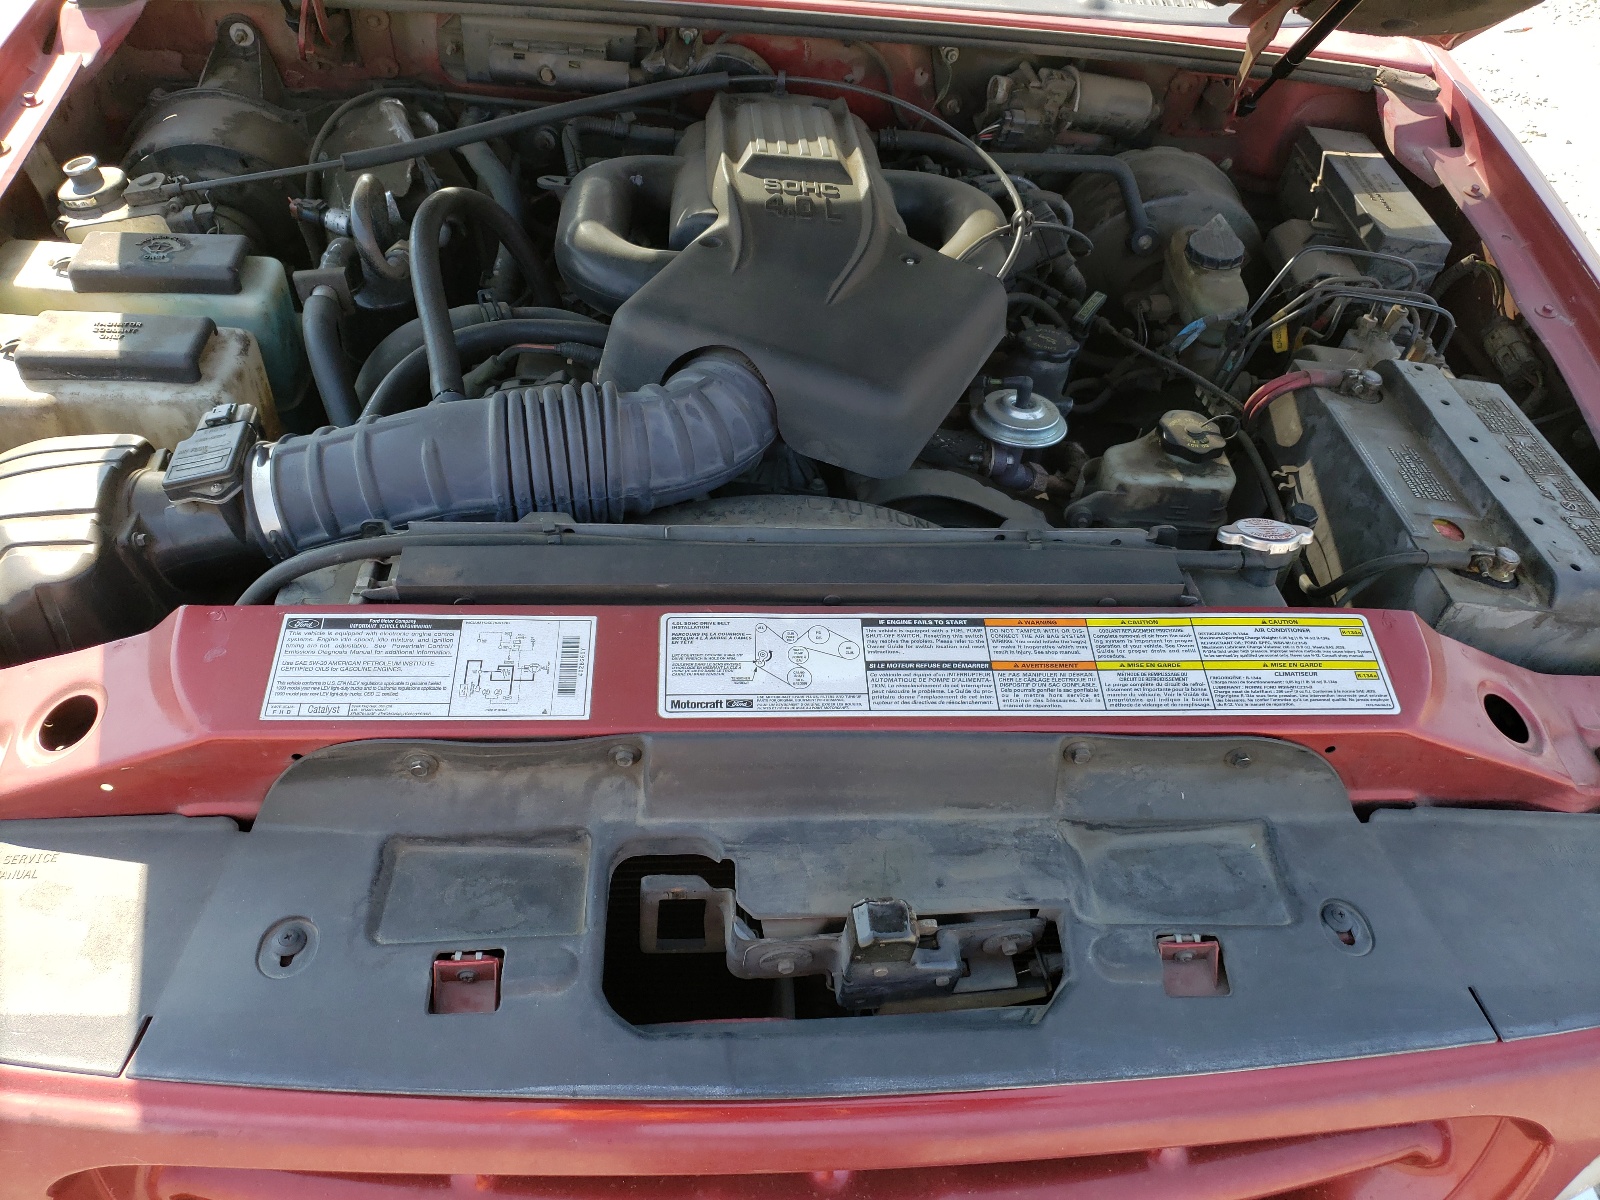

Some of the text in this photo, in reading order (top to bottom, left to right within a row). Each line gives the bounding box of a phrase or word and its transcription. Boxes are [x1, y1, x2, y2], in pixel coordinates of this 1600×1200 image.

[764, 178, 840, 199] SOHC
[671, 700, 723, 709] Motorcraft
[308, 705, 340, 717] Catalyst
[3, 853, 60, 864] SERVICE
[0, 869, 38, 880] ANUAL
